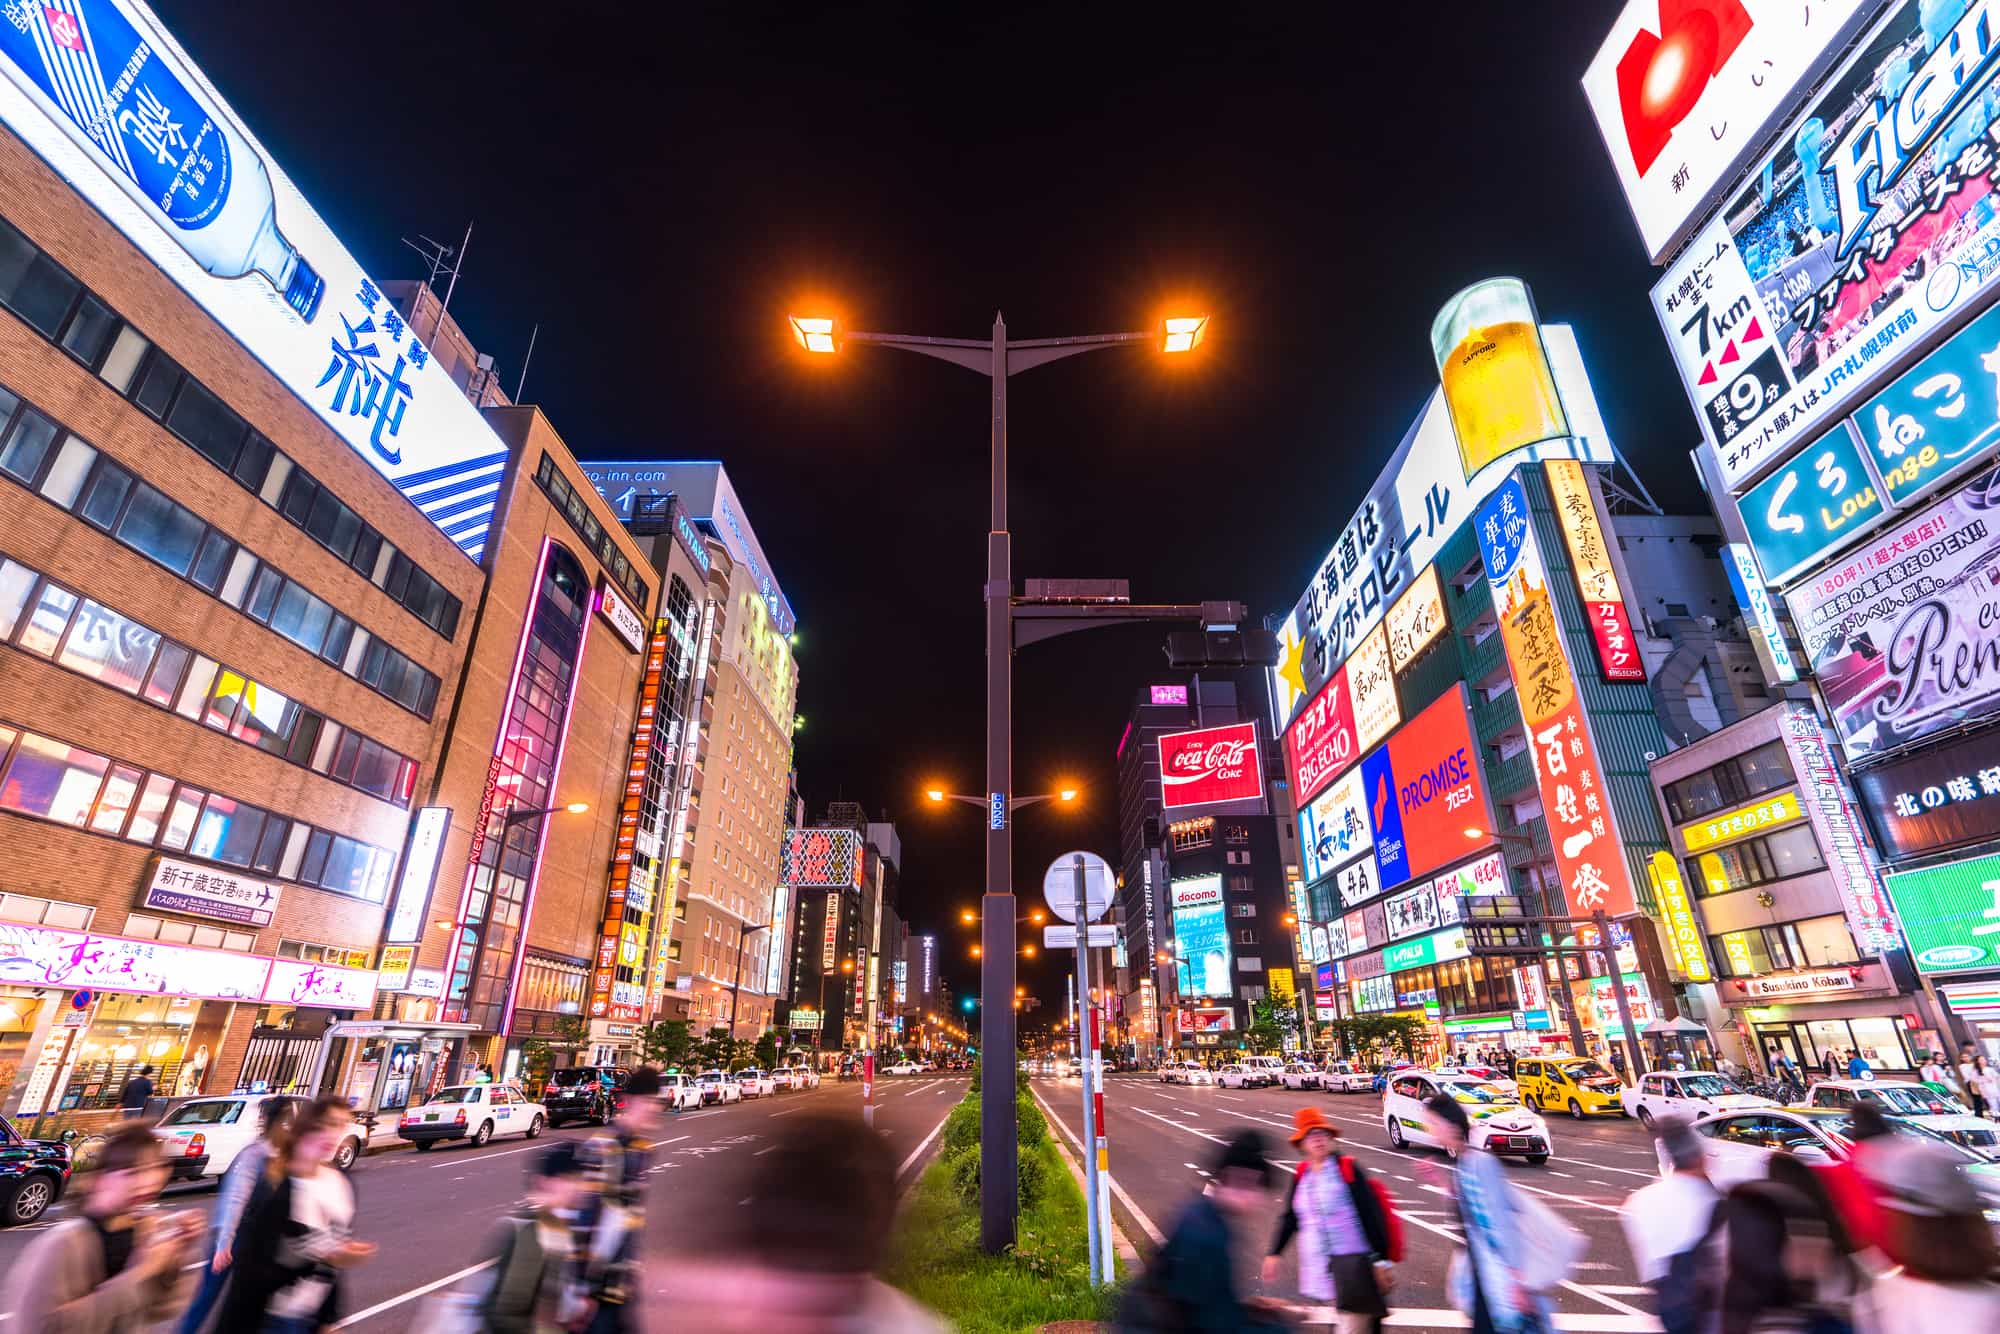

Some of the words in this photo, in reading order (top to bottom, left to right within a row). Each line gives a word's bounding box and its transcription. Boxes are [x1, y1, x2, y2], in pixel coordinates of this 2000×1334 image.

[119, 83, 189, 167] 純
[1666, 242, 1729, 312] 札幌ドーム
[1692, 274, 1713, 305] まで
[1462, 342, 1497, 367] SAPPORO
[315, 312, 413, 466] 純
[1821, 445, 1940, 531] Lounge
[1306, 502, 1380, 628] 北海道は
[1313, 481, 1451, 675] サッポロビール
[1599, 602, 1631, 666] カラオケ
[1296, 685, 1339, 751] カラオケ
[1168, 739, 1246, 774] Coca-Cola
[1401, 748, 1471, 815] PROMISE
[1444, 783, 1475, 813] プロミス
[1707, 800, 1787, 839] すすきの交番
[1178, 889, 1217, 903] docomo
[1348, 863, 1369, 897] 牛角
[1761, 979, 1809, 995] Susukino
